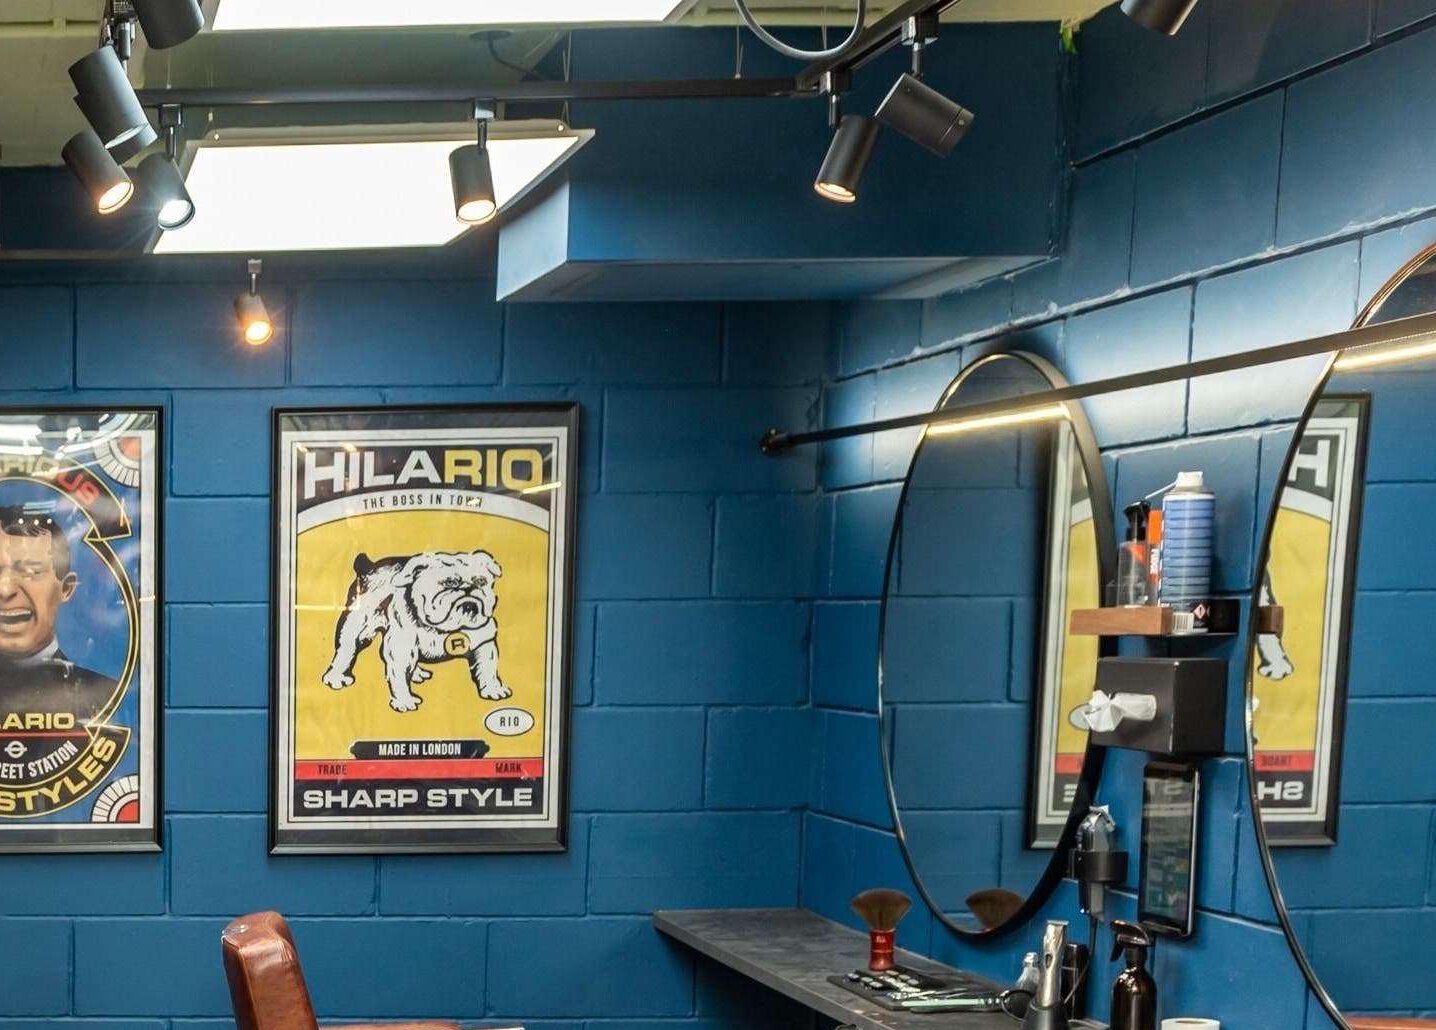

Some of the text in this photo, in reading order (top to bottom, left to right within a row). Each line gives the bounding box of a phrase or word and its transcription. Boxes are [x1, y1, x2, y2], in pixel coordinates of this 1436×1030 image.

[304, 448, 544, 499] HILARIO
[363, 496, 385, 510] THE
[392, 494, 423, 506] BOSS
[429, 493, 442, 505] IN
[499, 716, 520, 728] RIO
[378, 743, 462, 756] MADE IN LONDON
[29, 740, 79, 777] STATION
[318, 764, 348, 776] TRADE
[495, 762, 523, 774] MARK
[303, 787, 533, 809] SHARP STYLE
